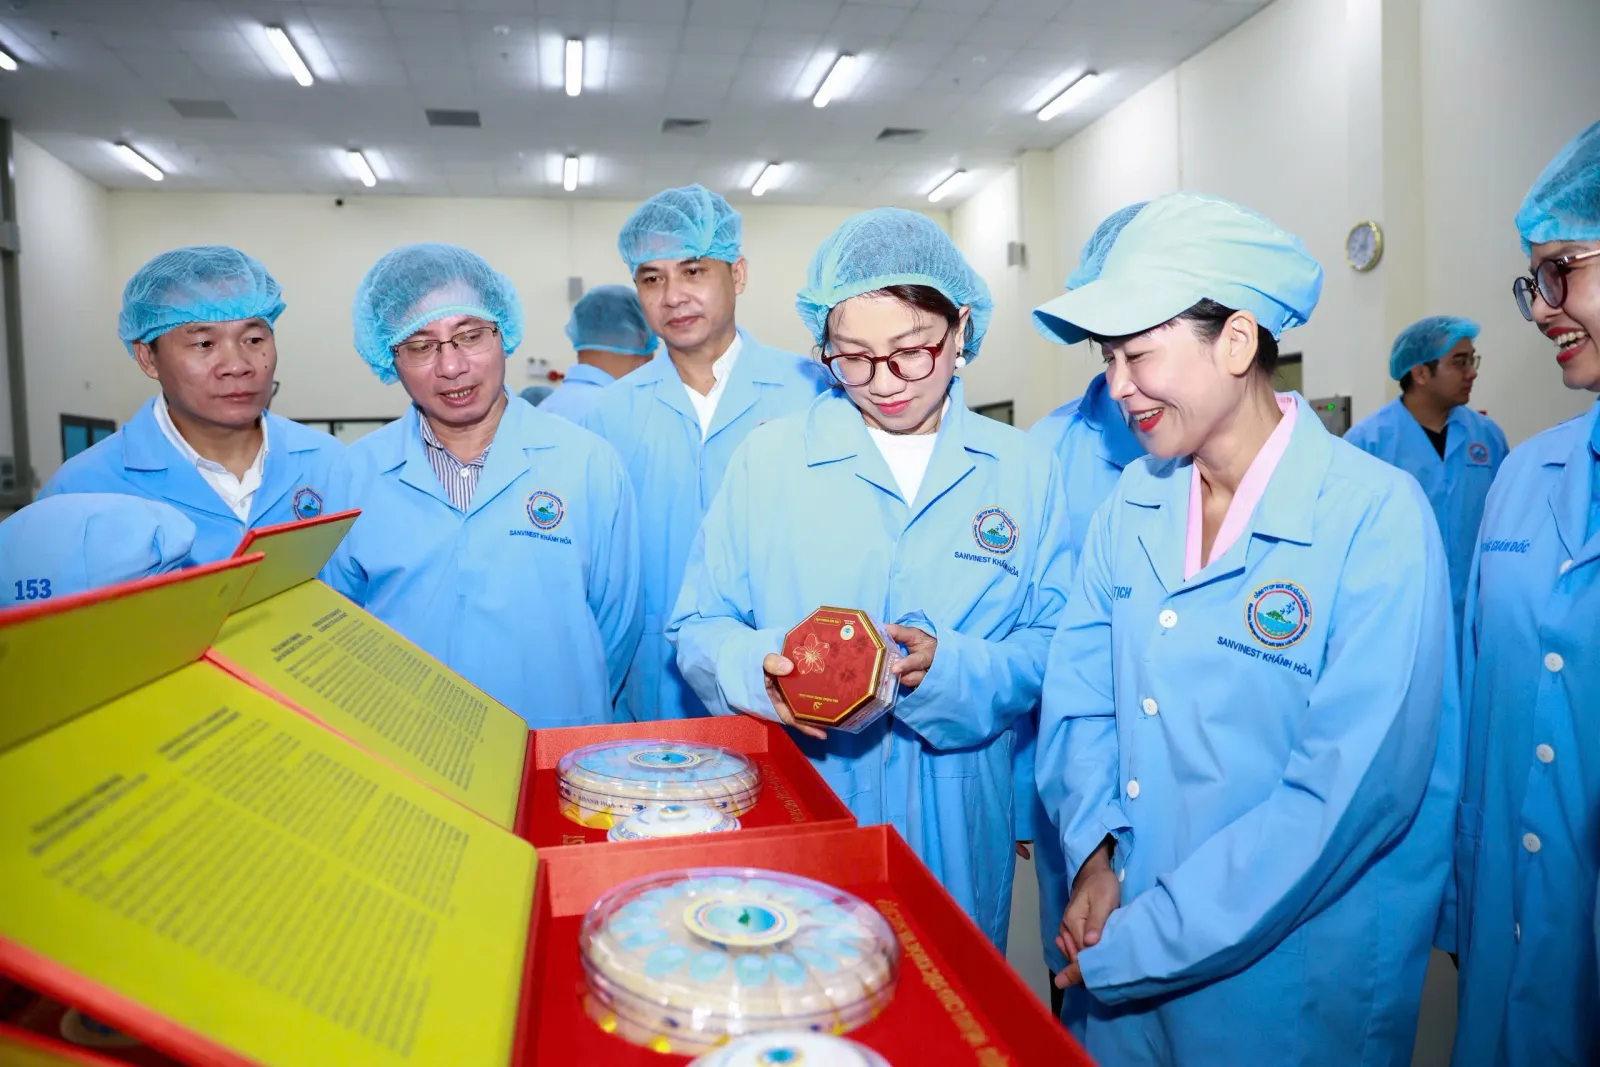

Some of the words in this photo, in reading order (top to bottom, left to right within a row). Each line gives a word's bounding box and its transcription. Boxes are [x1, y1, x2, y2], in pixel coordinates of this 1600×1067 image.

[509, 529, 540, 539] SANVINEST
[954, 551, 991, 564] SANVINEST
[14, 578, 52, 601] 153
[1113, 585, 1132, 601] TỊCH
[1217, 636, 1262, 659] SANVINEST
[1262, 653, 1293, 669] KHÁNH
[1293, 662, 1312, 678] HÒA
